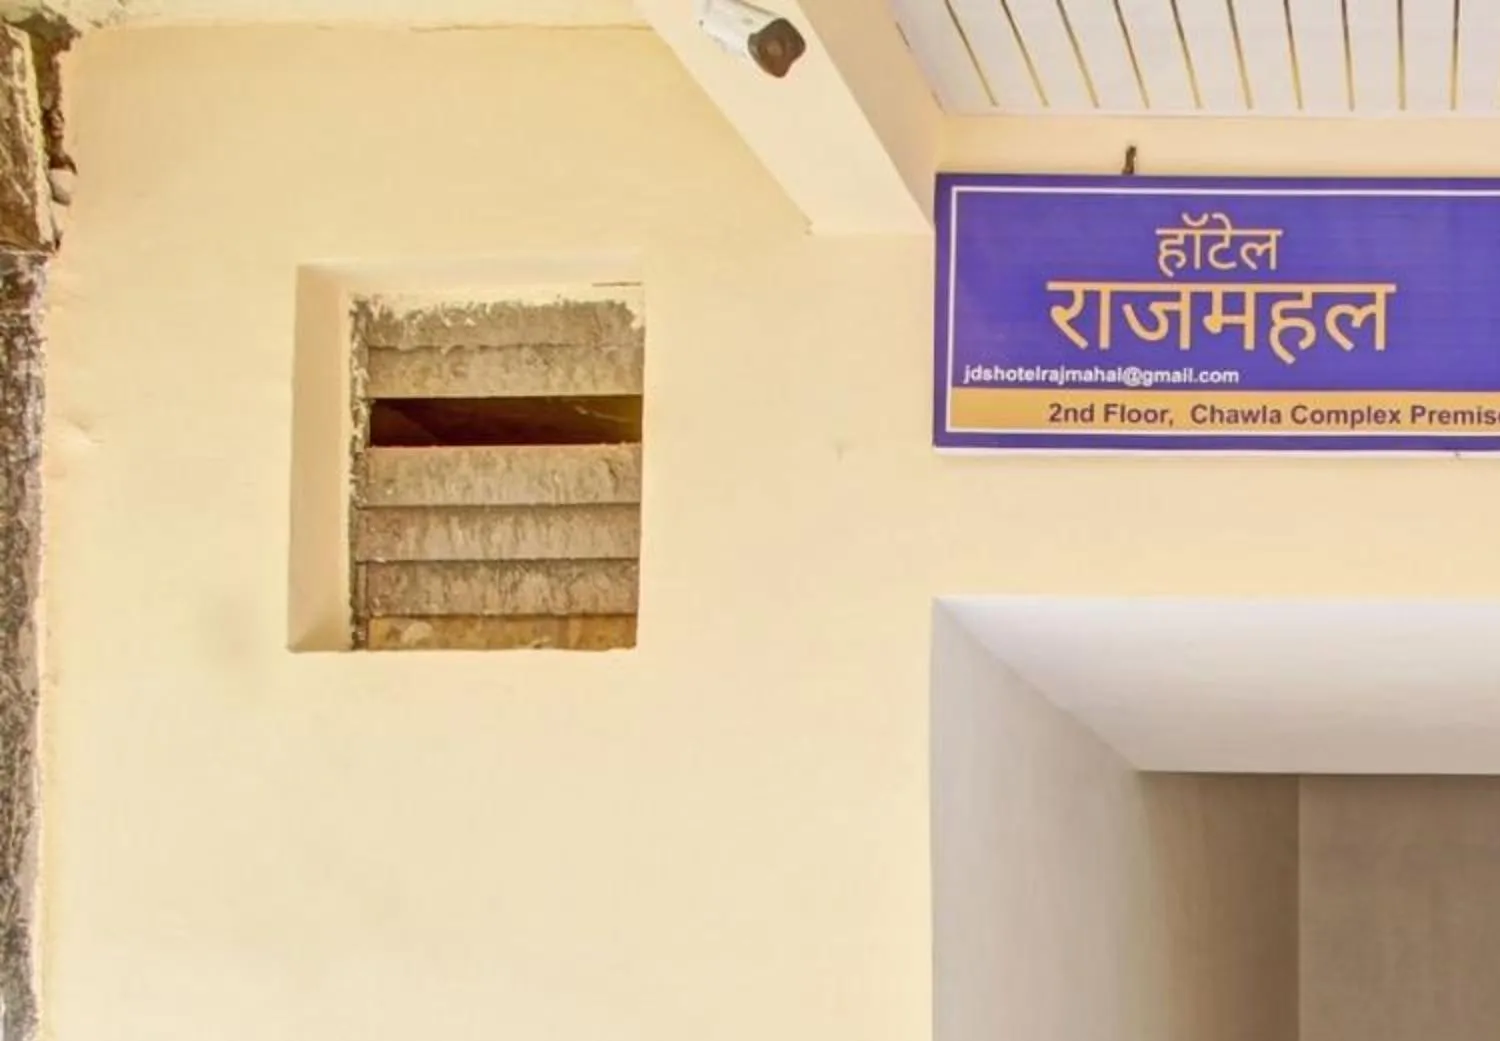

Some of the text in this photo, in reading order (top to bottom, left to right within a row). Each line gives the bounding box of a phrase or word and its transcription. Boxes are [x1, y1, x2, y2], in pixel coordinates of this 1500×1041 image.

[1155, 212, 1283, 277] हॉटेल
[1046, 281, 1397, 365] राजमहल
[963, 364, 1240, 387] jdshotelrajmahal@gmail.com
[1049, 402, 1095, 424] 2nd
[1103, 403, 1174, 427] Floor,
[1190, 403, 1282, 425] Chawla
[1290, 404, 1401, 429] Complex
